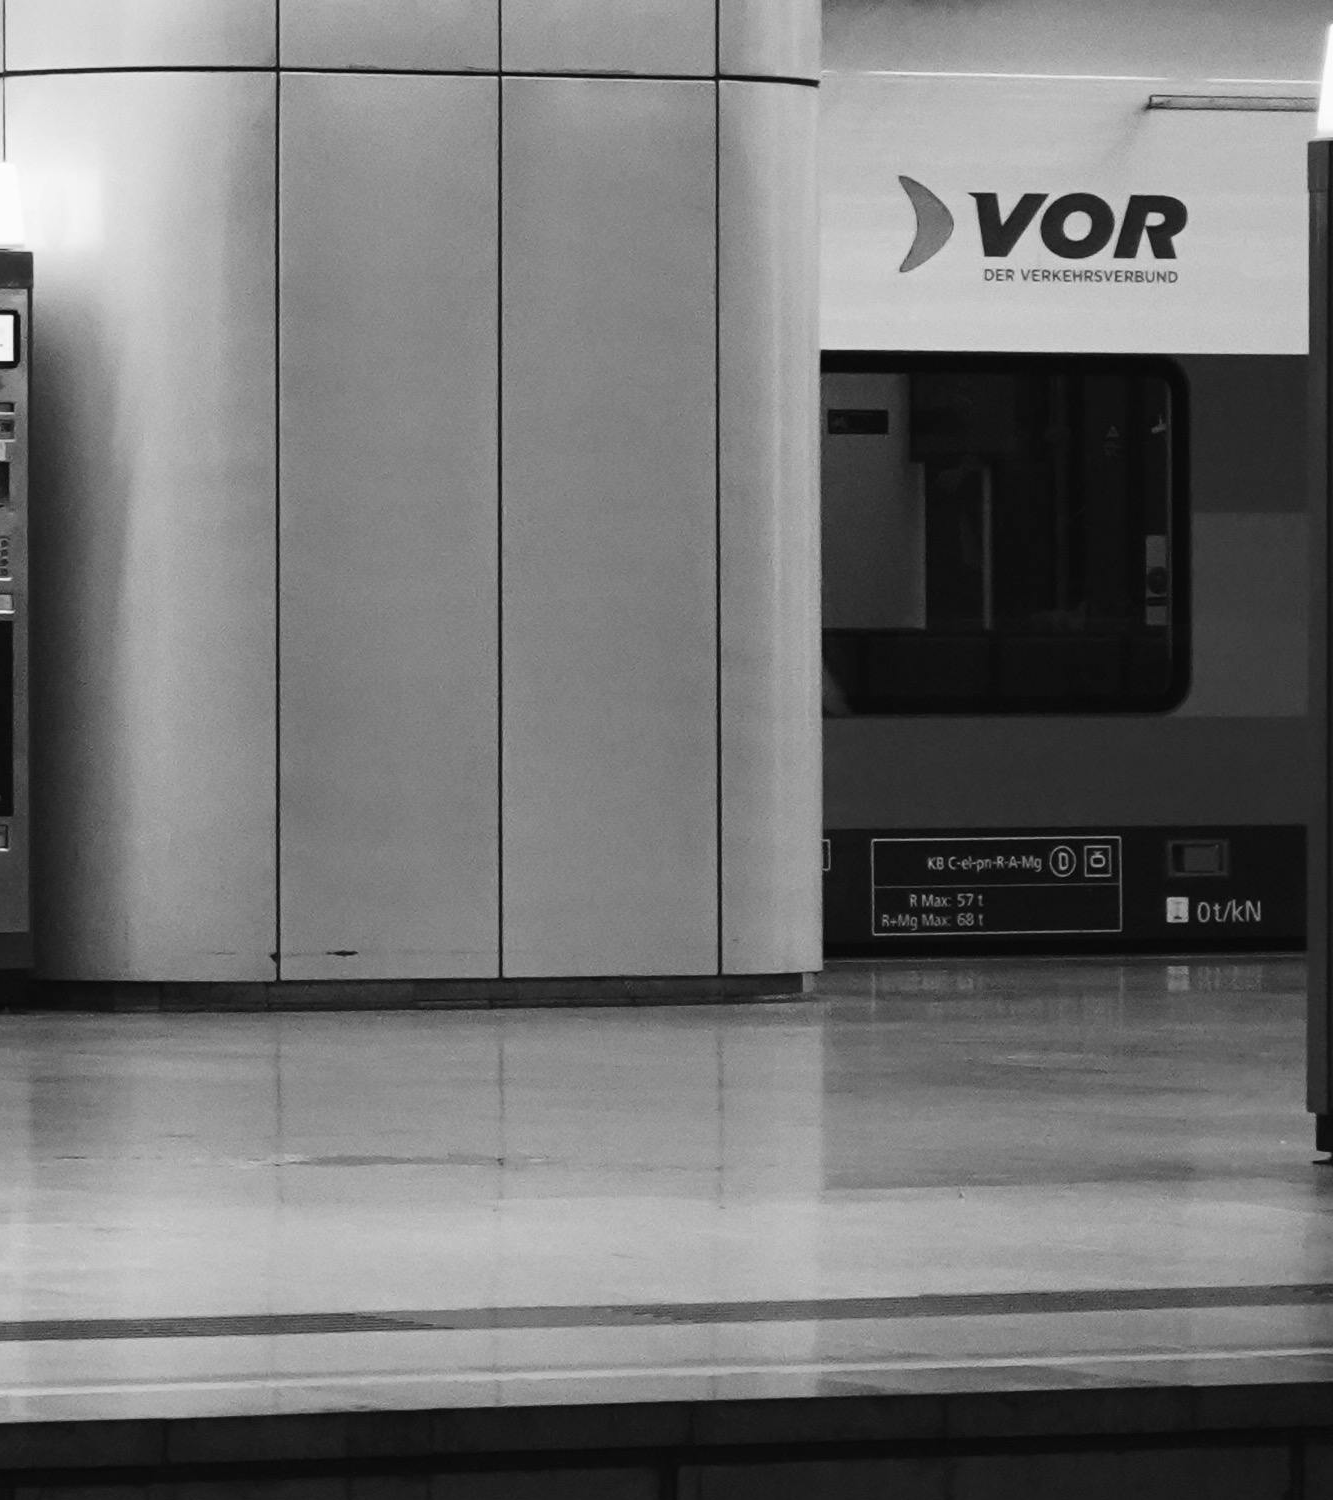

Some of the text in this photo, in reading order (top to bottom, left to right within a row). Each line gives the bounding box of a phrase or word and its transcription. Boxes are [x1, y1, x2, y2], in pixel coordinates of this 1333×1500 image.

[967, 192, 1188, 259] VOR
[983, 268, 1178, 283] DER VERKEHRSVERBUND
[927, 856, 944, 870] KB
[909, 894, 918, 907] R
[957, 893, 974, 907] 57
[957, 913, 974, 927] 68
